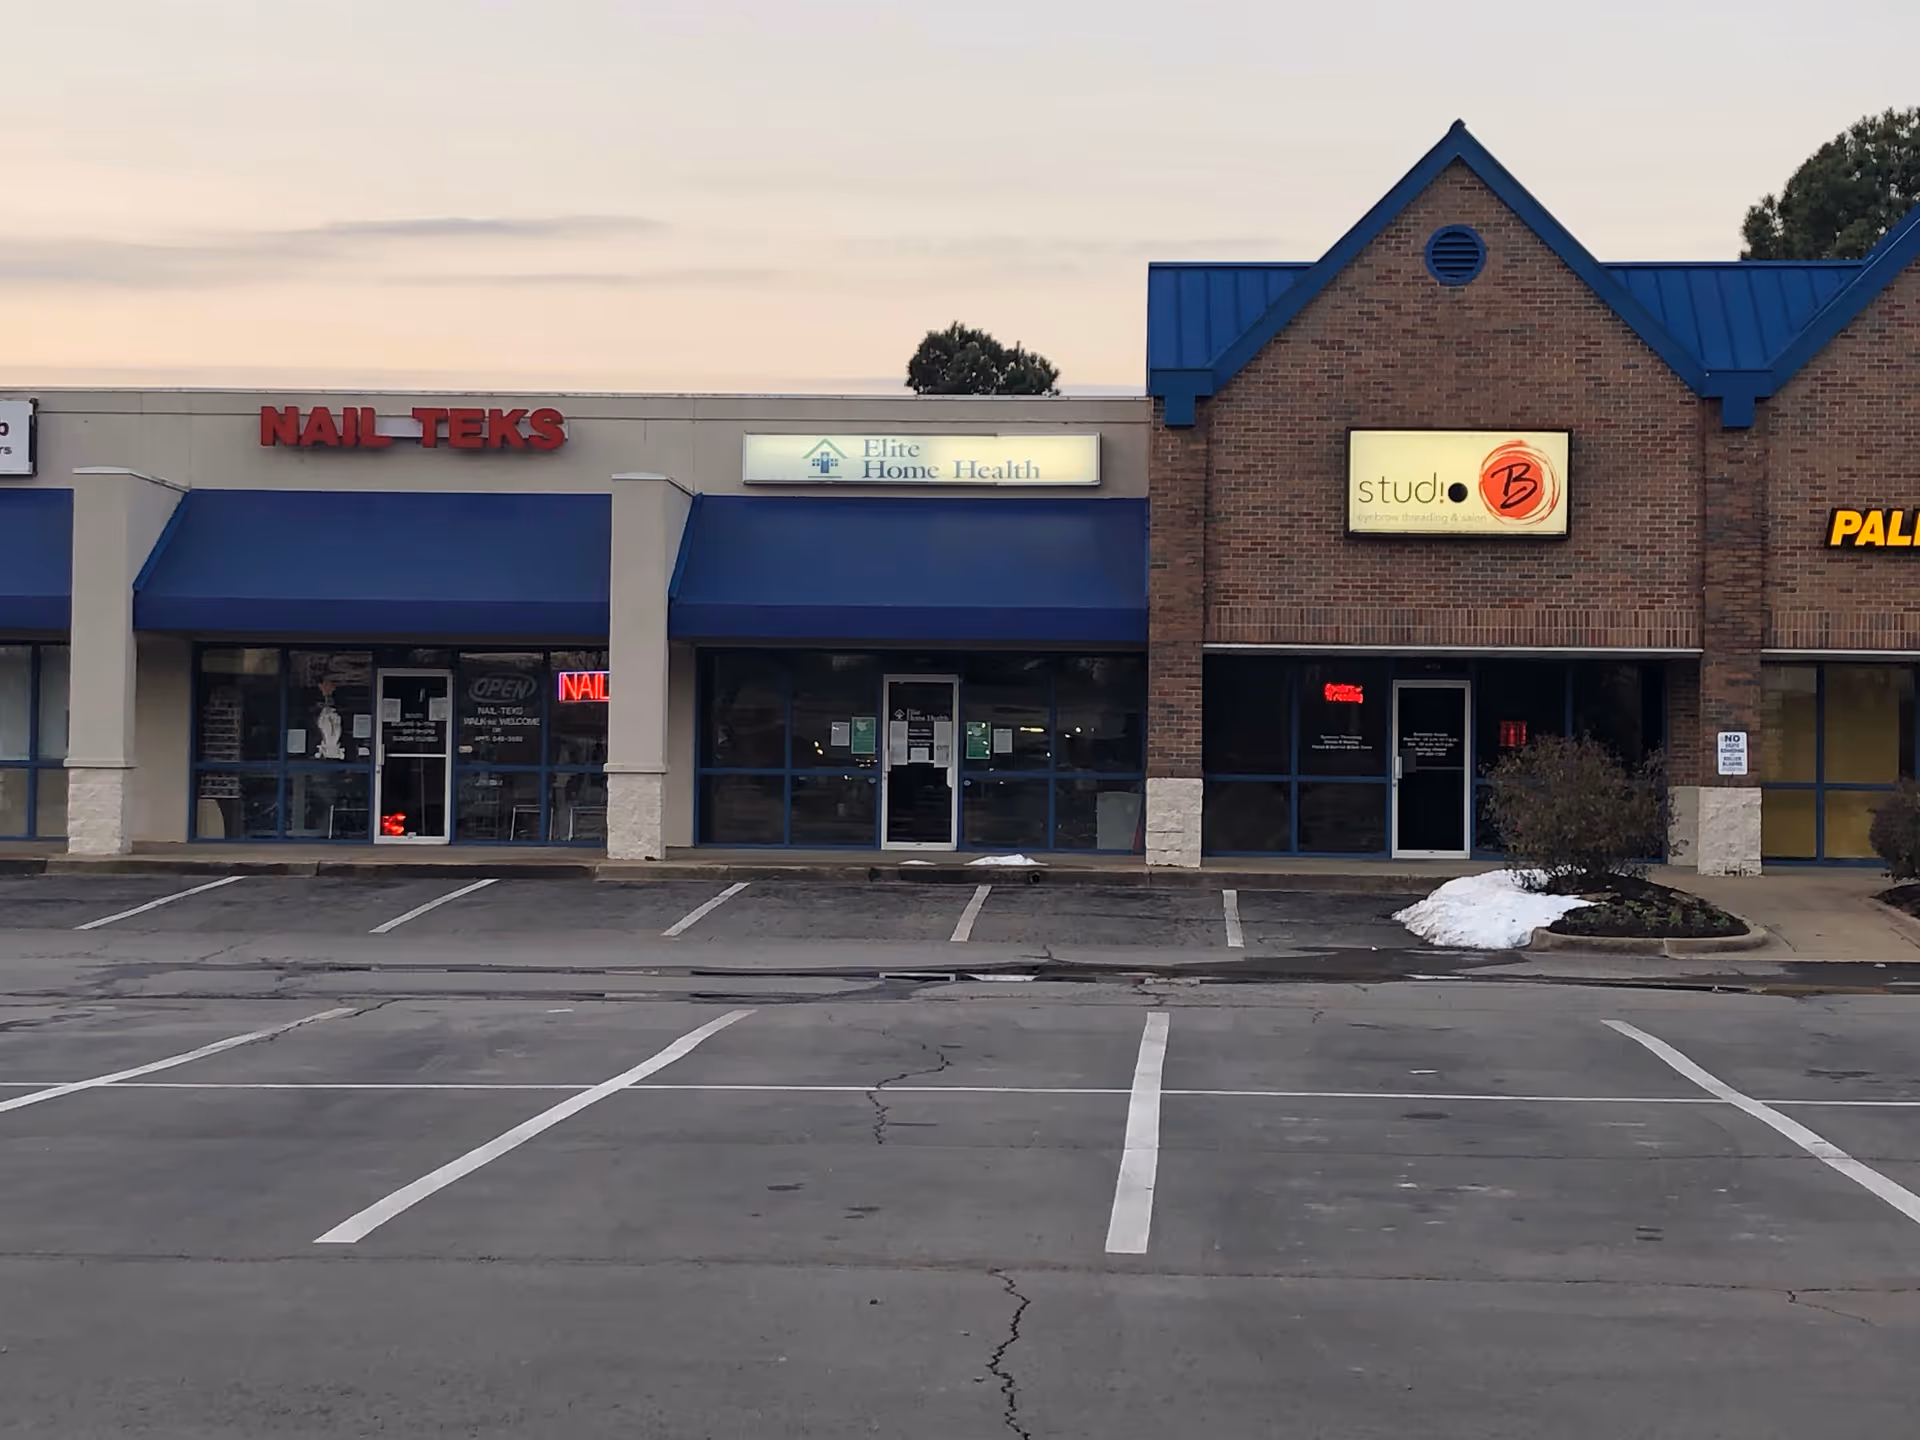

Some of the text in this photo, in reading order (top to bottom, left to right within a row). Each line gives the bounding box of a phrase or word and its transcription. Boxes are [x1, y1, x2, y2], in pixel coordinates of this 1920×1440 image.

[260, 406, 567, 450] NAIL TEKS
[862, 438, 920, 458] Elite
[862, 459, 1040, 479] Home Health
[1491, 462, 1538, 510] B
[1402, 511, 1449, 524] threading
[1461, 512, 1487, 522] salon
[474, 677, 528, 699] OPEN
